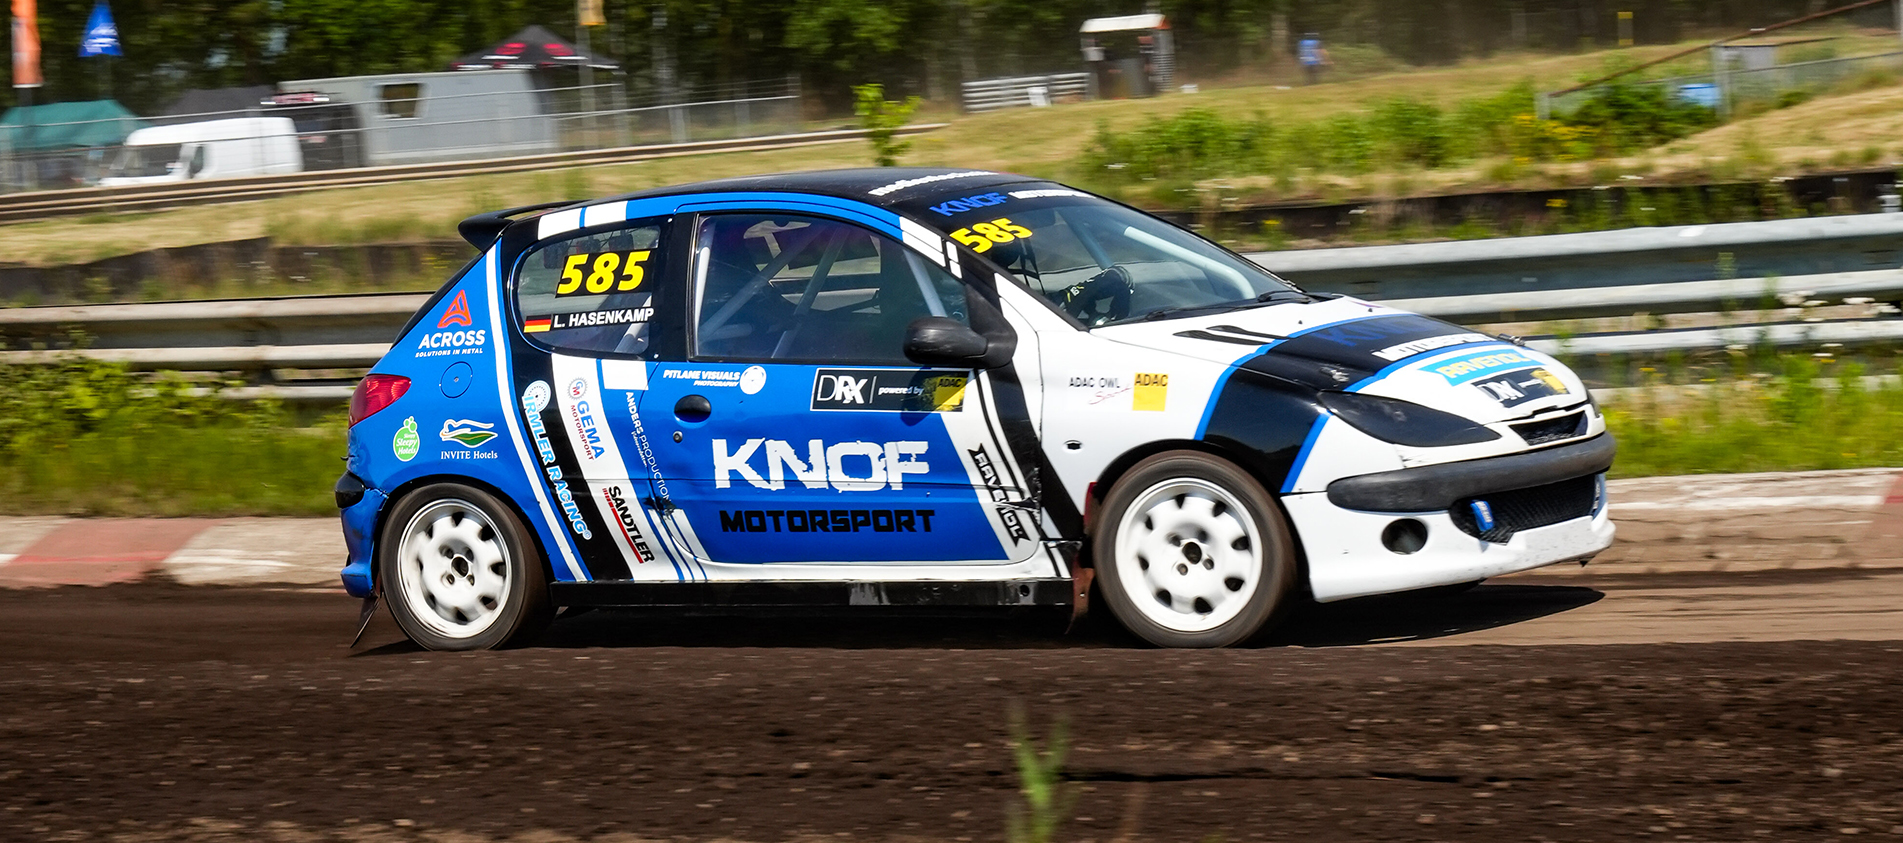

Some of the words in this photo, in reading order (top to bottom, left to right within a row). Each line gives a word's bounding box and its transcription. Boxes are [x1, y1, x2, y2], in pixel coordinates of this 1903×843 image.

[949, 218, 1032, 253] 585
[556, 250, 651, 294] 585
[553, 315, 565, 328] L.
[568, 308, 655, 327] HASENKAMP
[417, 329, 486, 349] ACROSS
[415, 349, 451, 358] SOLUTIONS
[461, 347, 484, 355] METAL
[663, 369, 701, 380] PITLANE
[702, 370, 740, 381] VISUALS
[1435, 352, 1532, 378] RAVENOL
[816, 375, 868, 404] DRX
[878, 386, 912, 396] powered
[912, 386, 924, 396] by
[937, 378, 962, 388] ADAC
[1069, 377, 1095, 388] ADAC
[1134, 374, 1168, 387] ADAC
[626, 391, 644, 434] ANDERS
[523, 396, 555, 464] IRMLER
[571, 405, 594, 460] MOTORSPORT
[577, 400, 605, 459] GEMA
[396, 437, 418, 448] Sleepy
[397, 446, 417, 456] Hotels
[440, 450, 471, 460] INVITE
[473, 450, 498, 459] Hotels
[712, 437, 930, 494] KNOF
[608, 485, 656, 563] SANDTLER
[719, 509, 935, 533] MOTORSPORT
